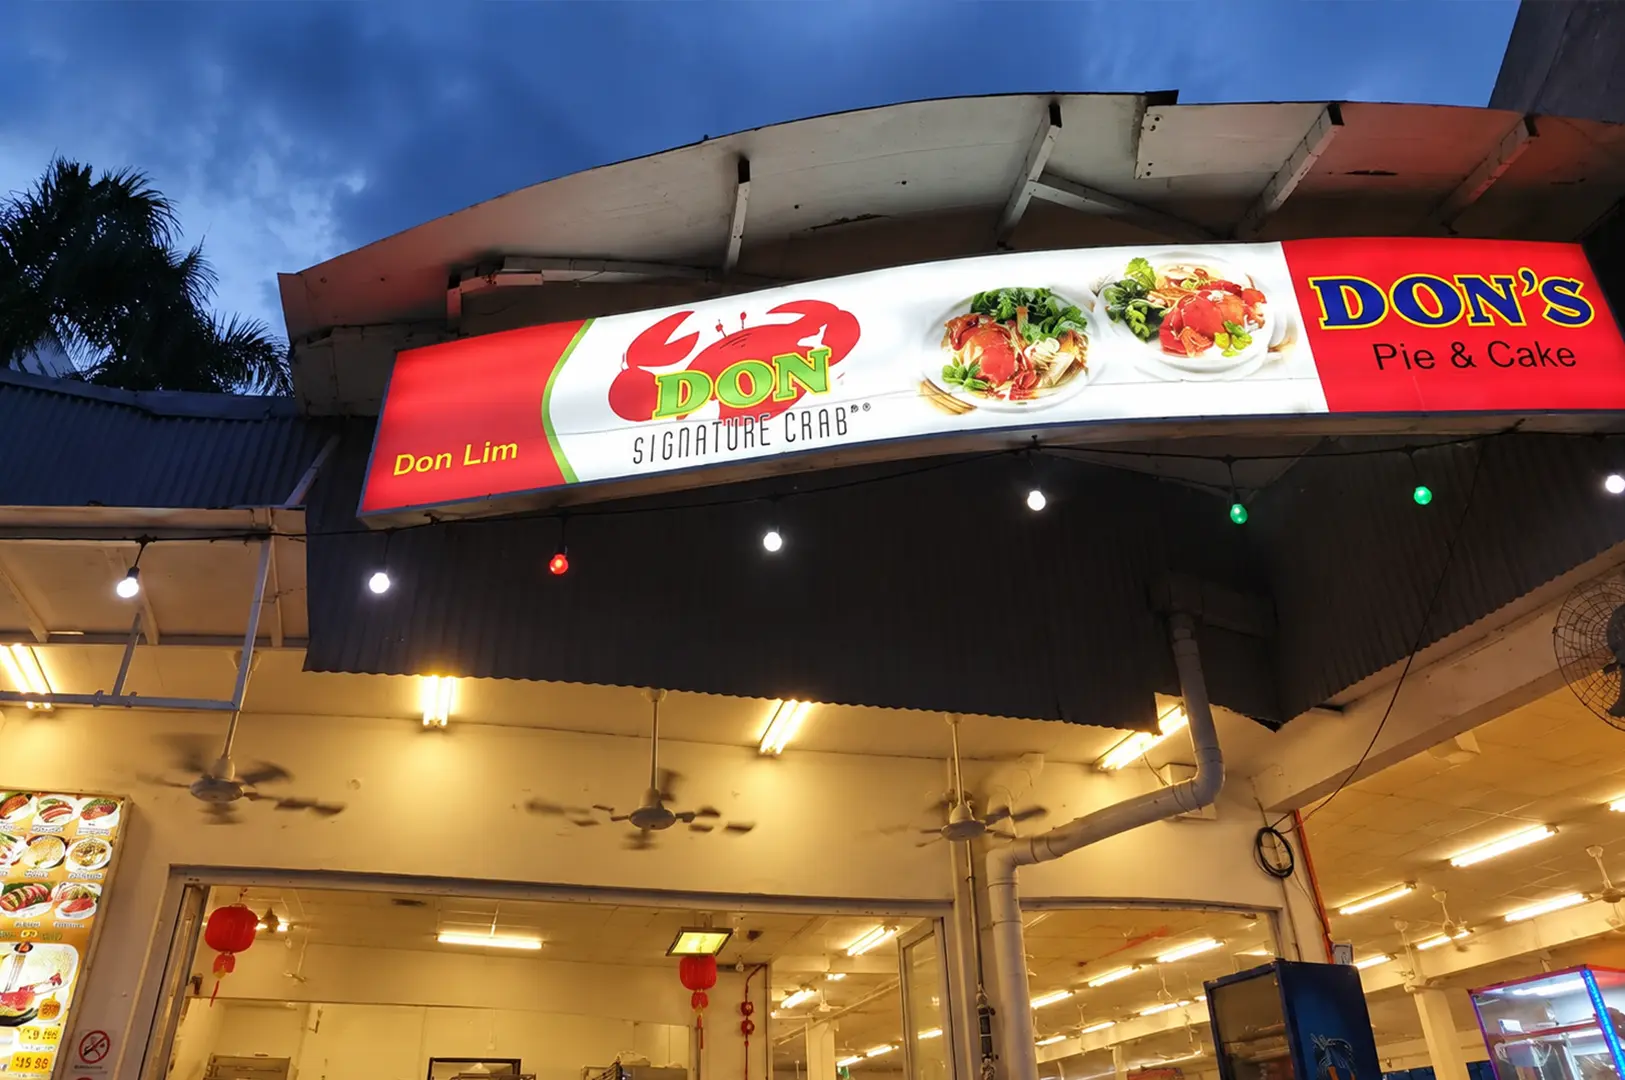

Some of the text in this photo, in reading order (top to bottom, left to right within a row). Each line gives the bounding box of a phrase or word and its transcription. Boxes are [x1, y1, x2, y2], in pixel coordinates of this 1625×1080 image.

[1308, 266, 1596, 330] DON'S
[1371, 339, 1577, 371] Pie & Cake
[652, 347, 832, 420] DON
[393, 440, 519, 477] Don Lim
[633, 413, 771, 465] SIGNATURE
